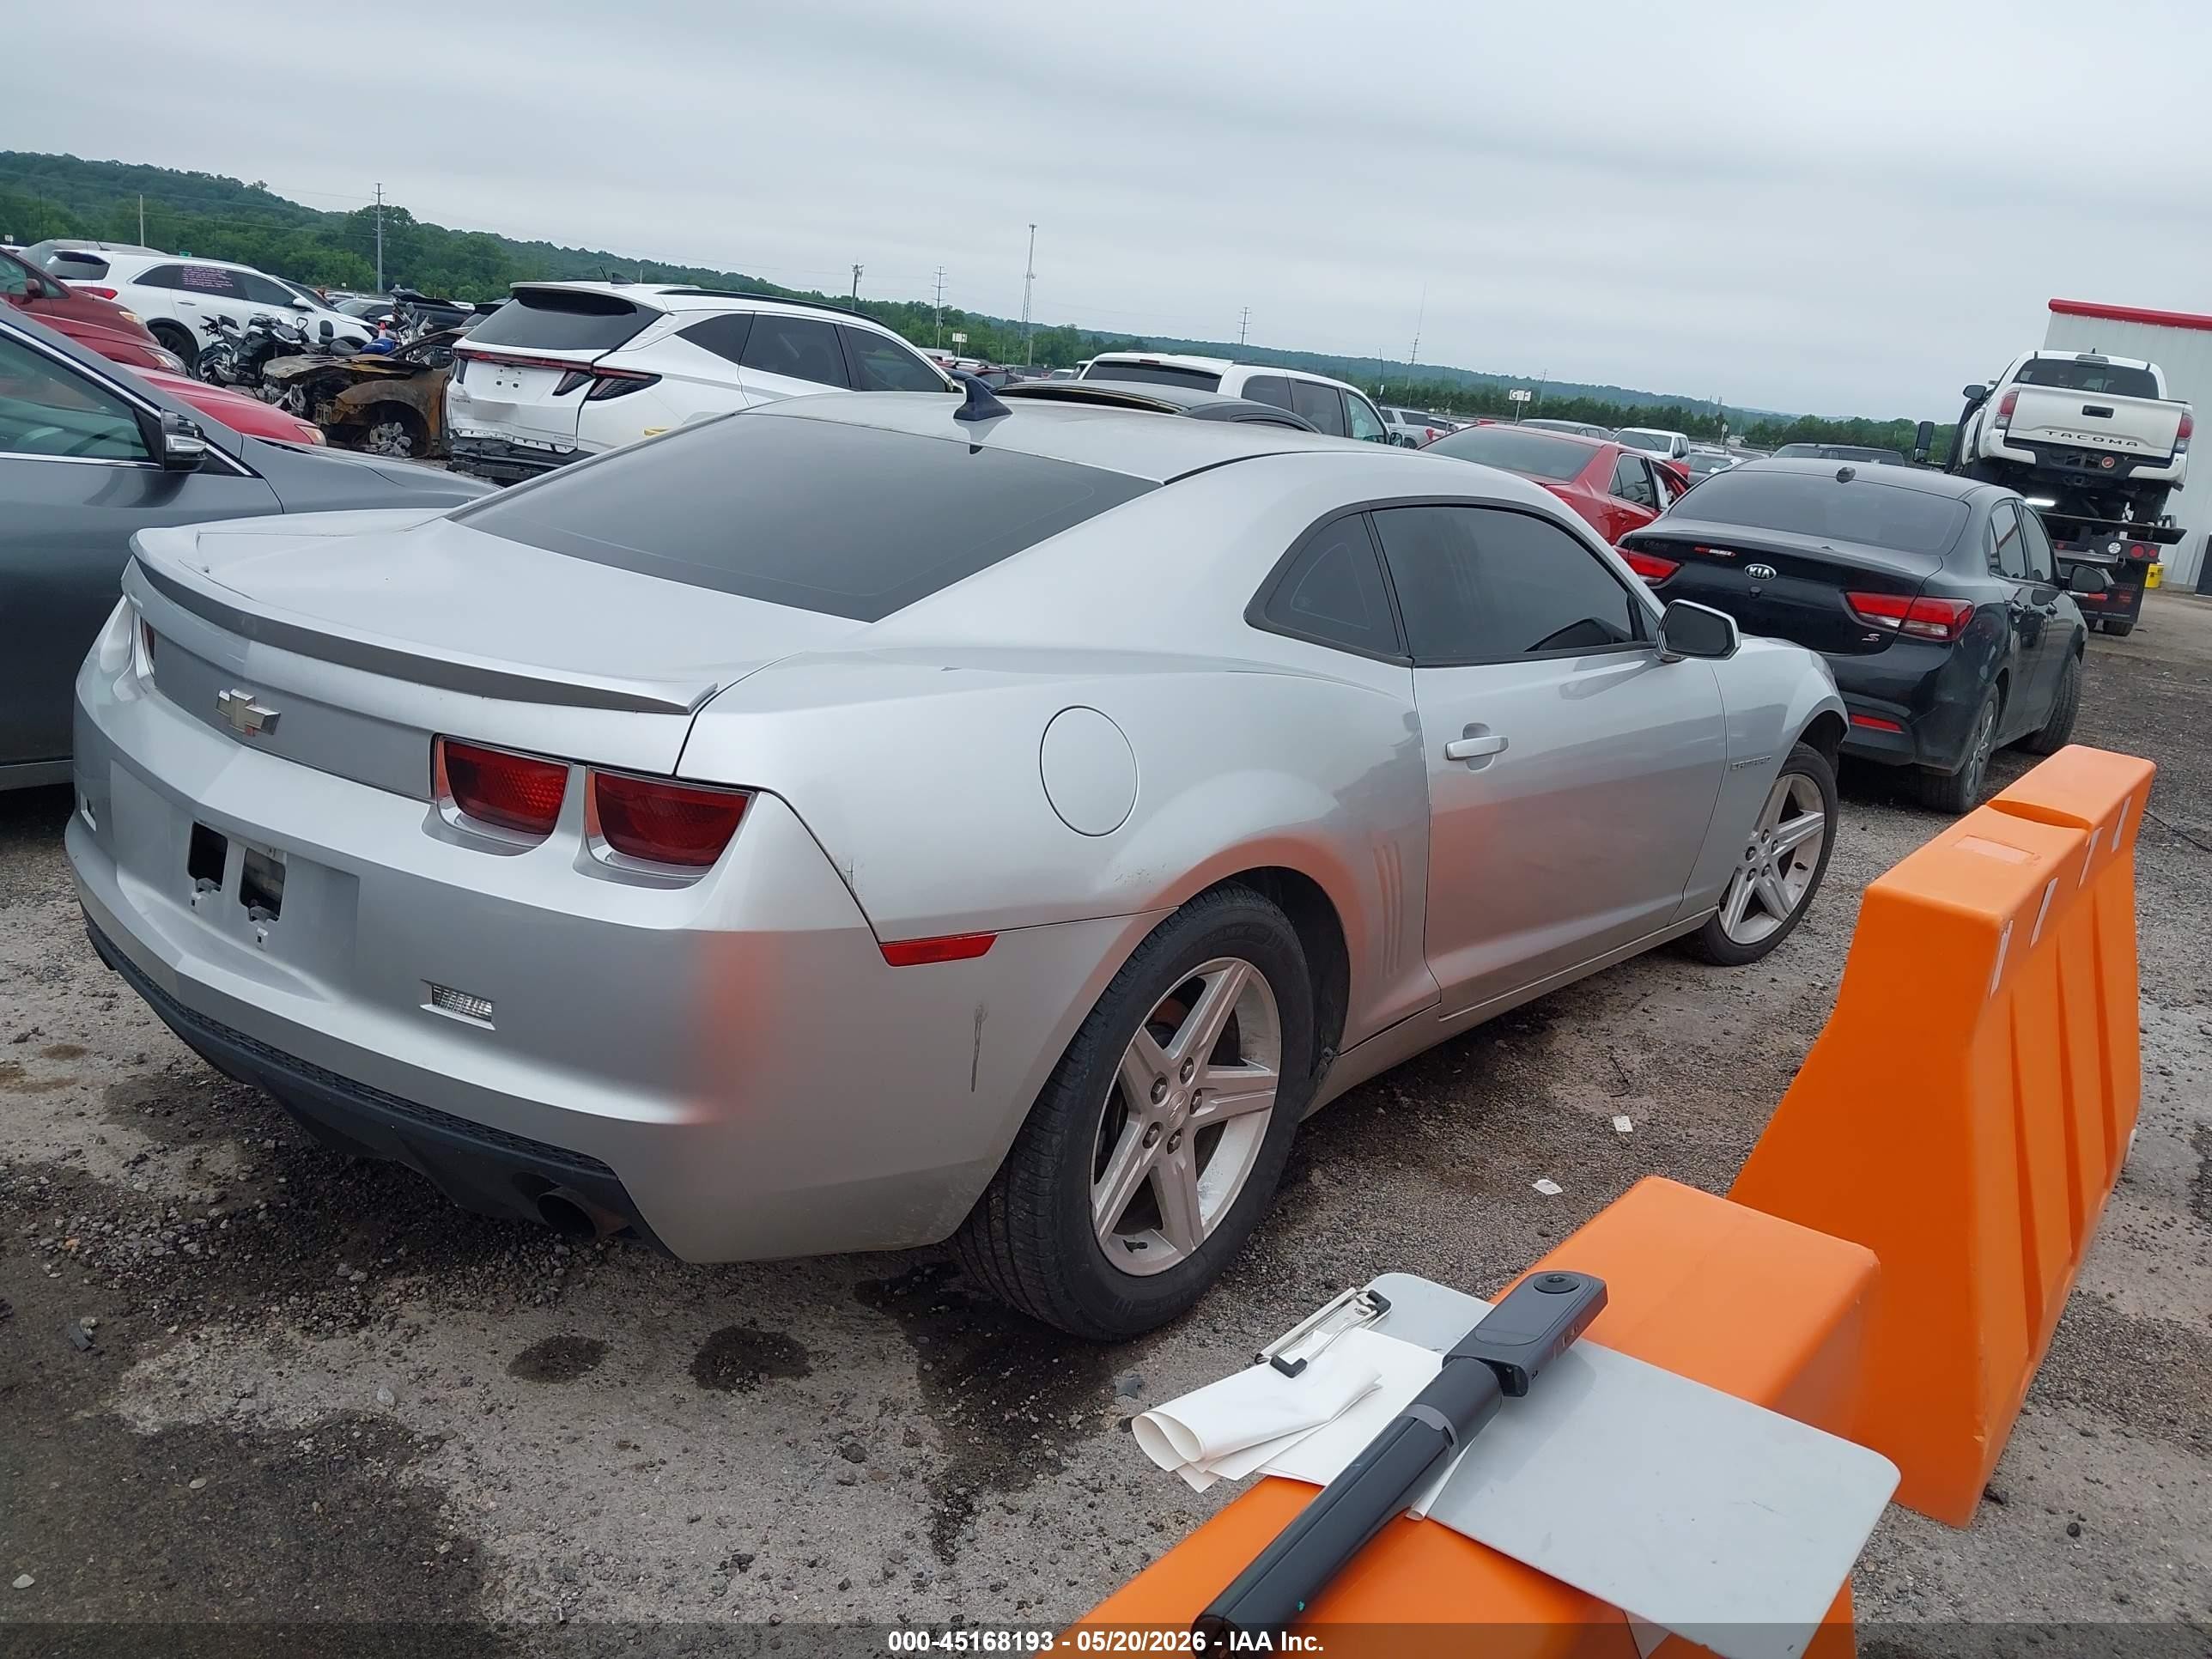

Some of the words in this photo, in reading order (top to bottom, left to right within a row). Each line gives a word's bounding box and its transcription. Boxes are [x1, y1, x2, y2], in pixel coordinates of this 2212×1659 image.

[1511, 390, 1518, 400] G
[1522, 391, 1530, 401] F
[2045, 430, 2138, 447] TACOMA
[1748, 566, 1771, 579] KIA
[1862, 633, 1881, 642] S
